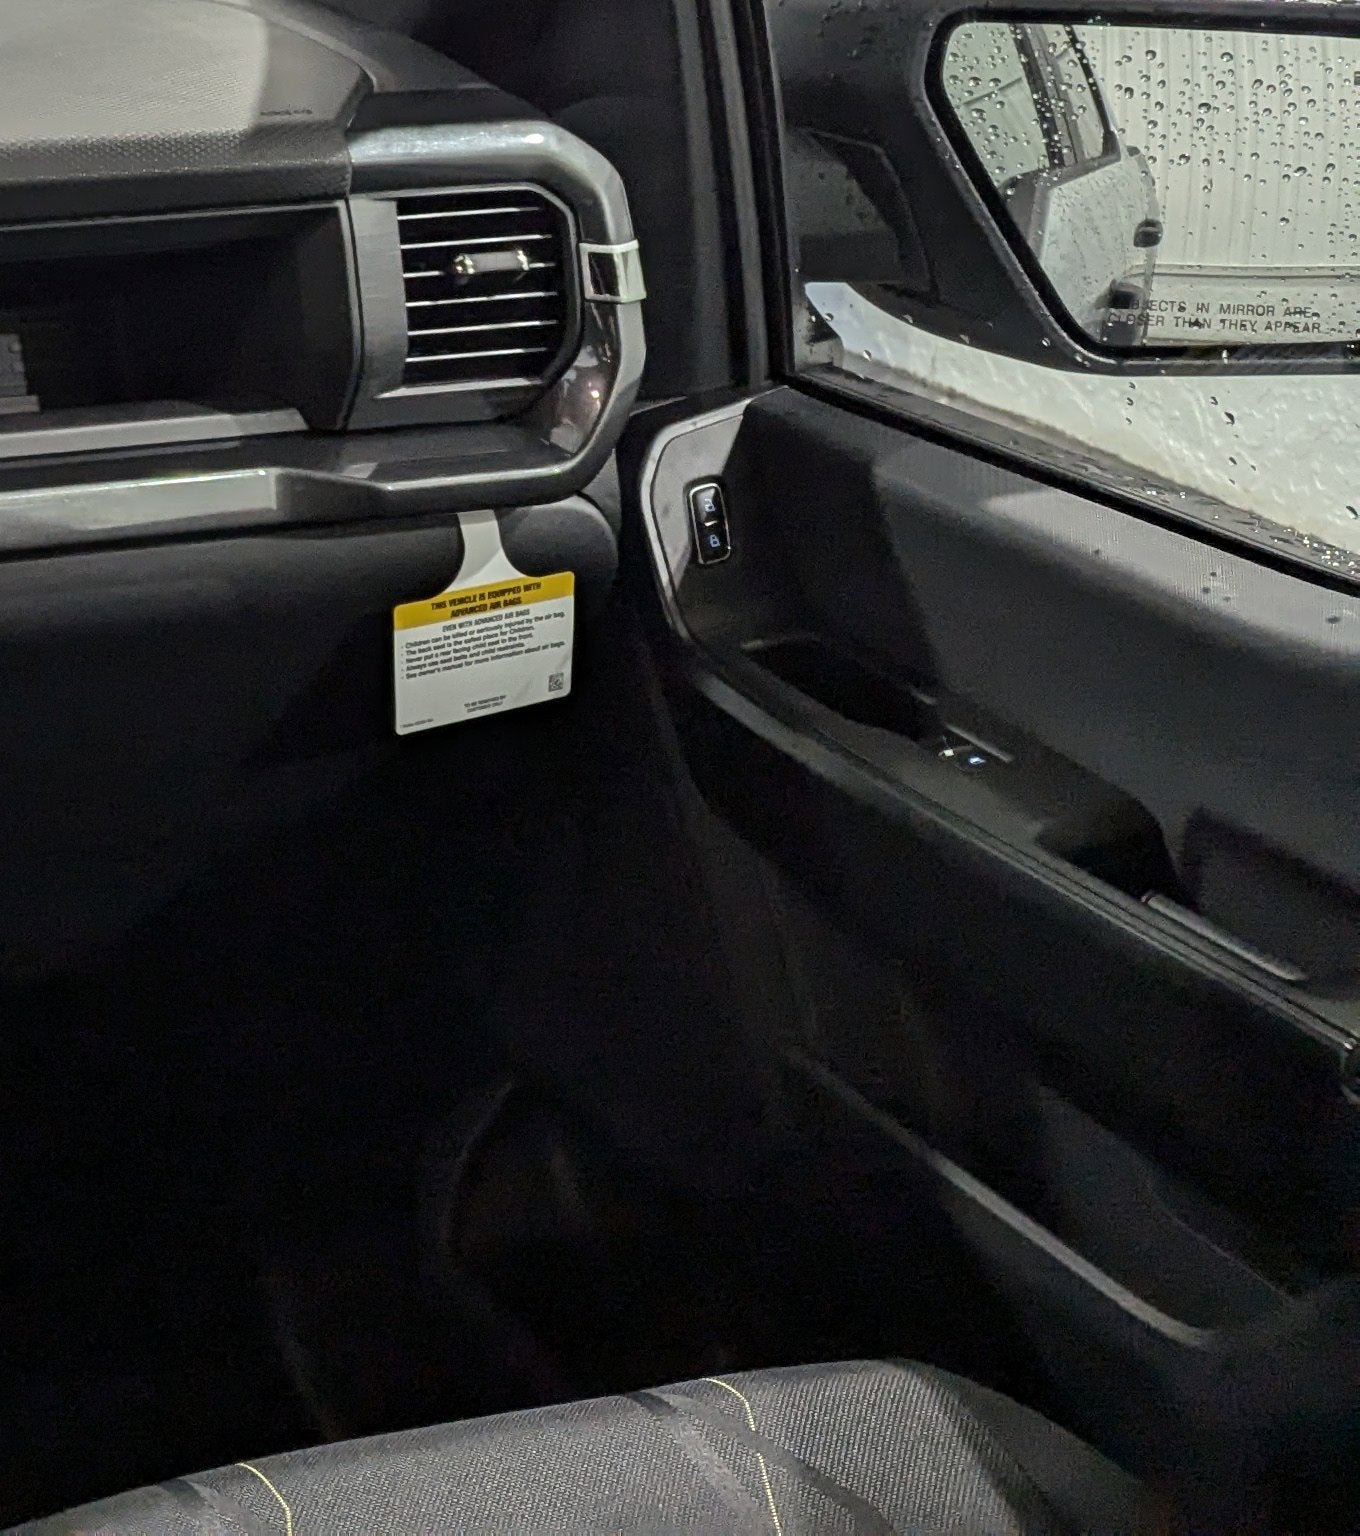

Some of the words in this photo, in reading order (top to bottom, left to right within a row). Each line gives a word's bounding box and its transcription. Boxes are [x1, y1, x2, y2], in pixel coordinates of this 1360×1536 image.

[1196, 302, 1210, 315] IN
[1219, 303, 1275, 316] MIRROR
[1174, 316, 1212, 329] THAN
[1220, 319, 1257, 331] THEY
[1264, 321, 1321, 333] APPEAR
[449, 596, 477, 607] VEHICLE
[488, 586, 521, 599] EQUIPPED
[523, 582, 541, 591] WITH
